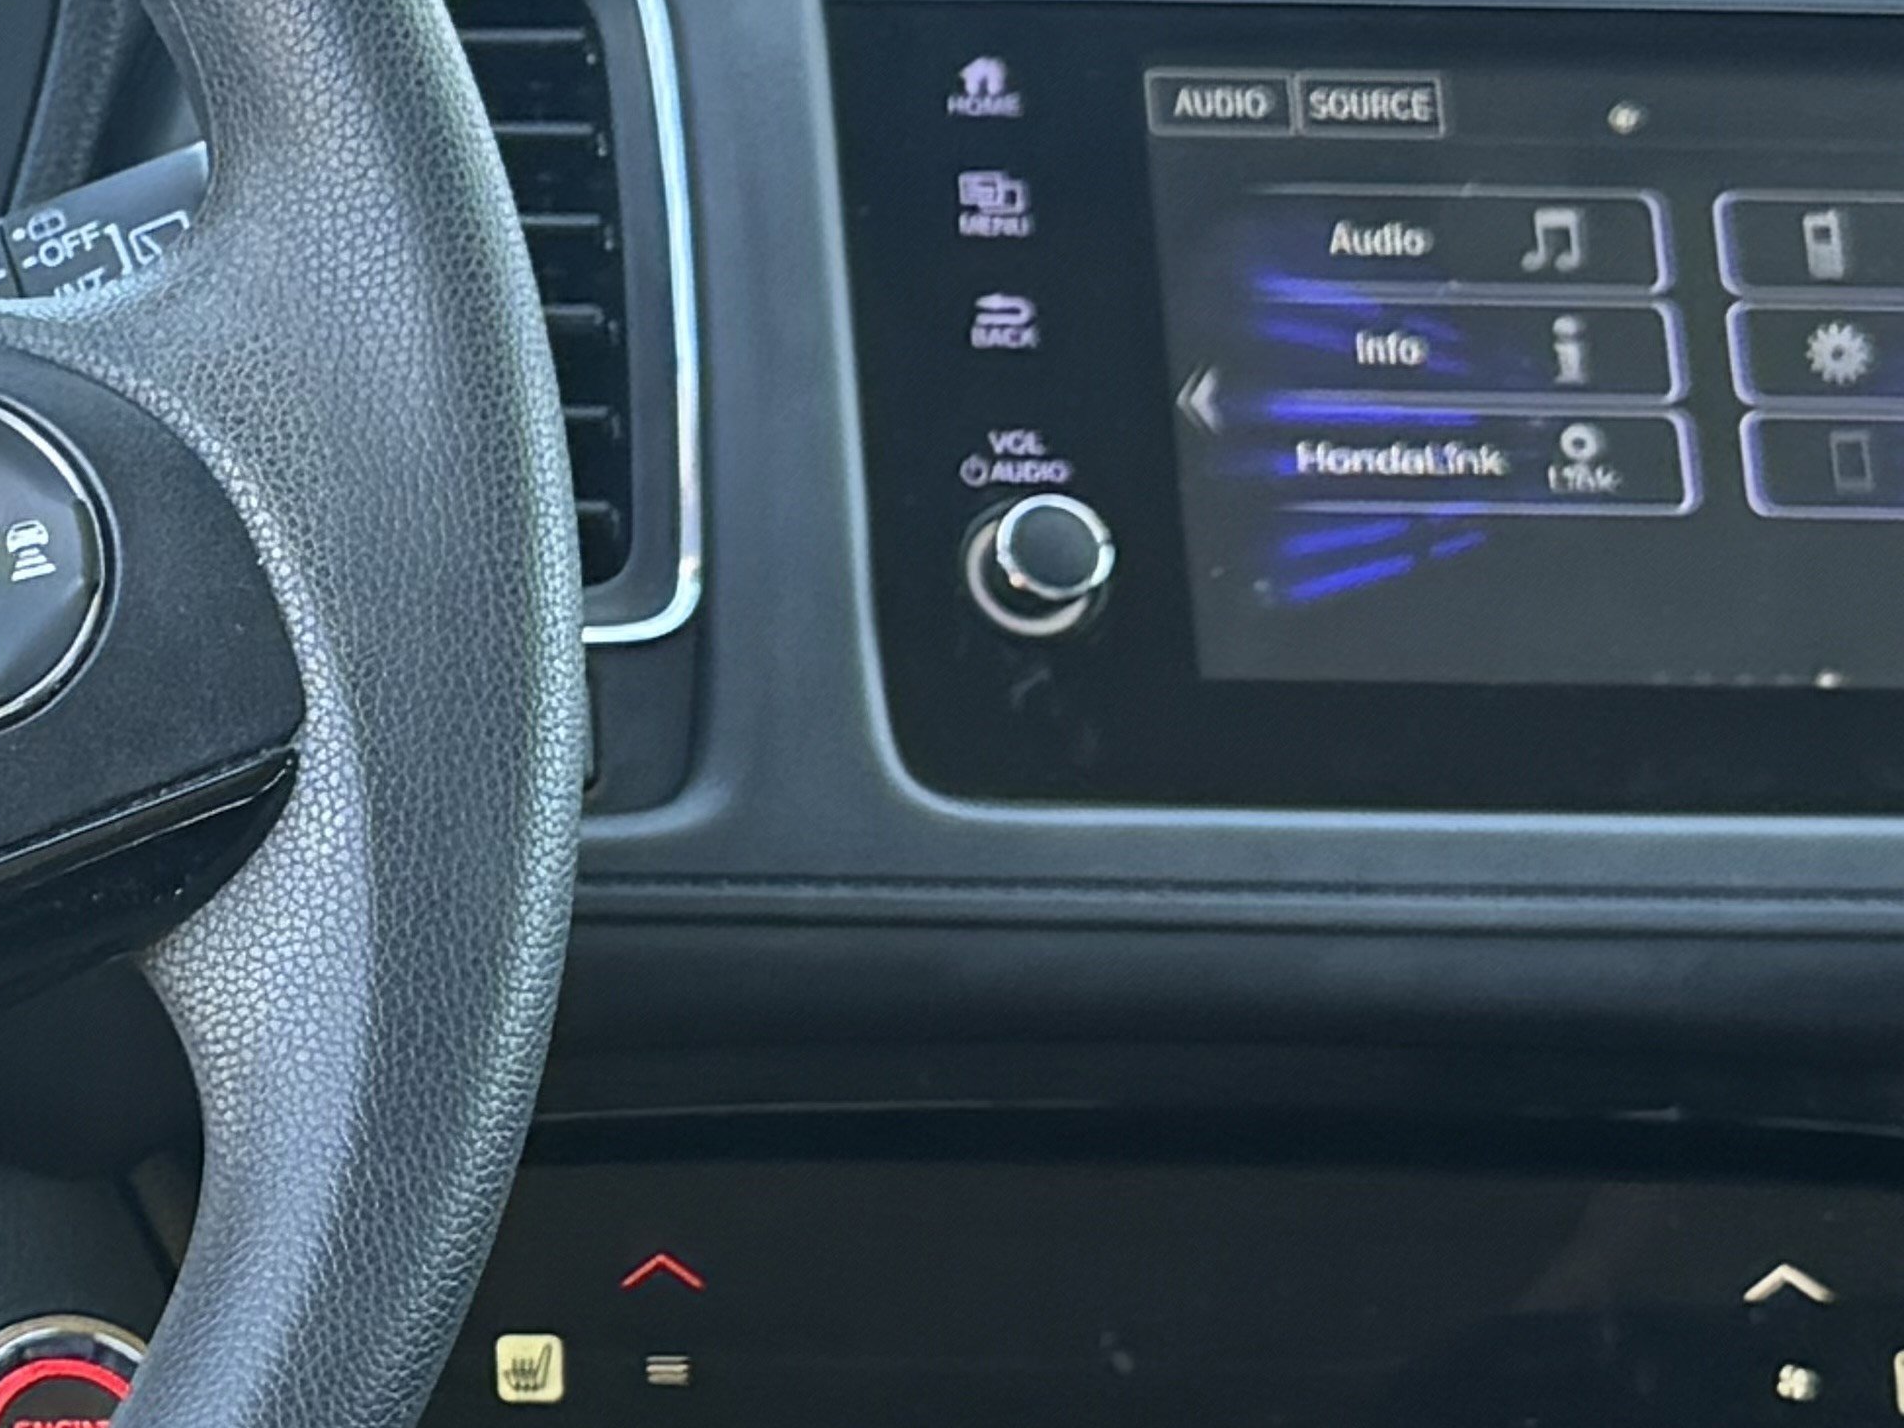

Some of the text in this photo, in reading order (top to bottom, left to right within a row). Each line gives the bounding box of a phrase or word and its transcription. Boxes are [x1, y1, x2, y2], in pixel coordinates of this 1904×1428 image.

[947, 94, 1024, 118] HOME
[1173, 87, 1435, 124] AUDIO SOURCE
[959, 213, 1032, 239] MENU
[1328, 220, 1430, 258] Audio
[39, 220, 100, 267] OFF
[970, 324, 1037, 349] BACK
[1355, 330, 1428, 367] Info
[990, 430, 1047, 457] VOL
[1295, 441, 1510, 477] HondaLink
[991, 458, 1070, 485] AUDIO
